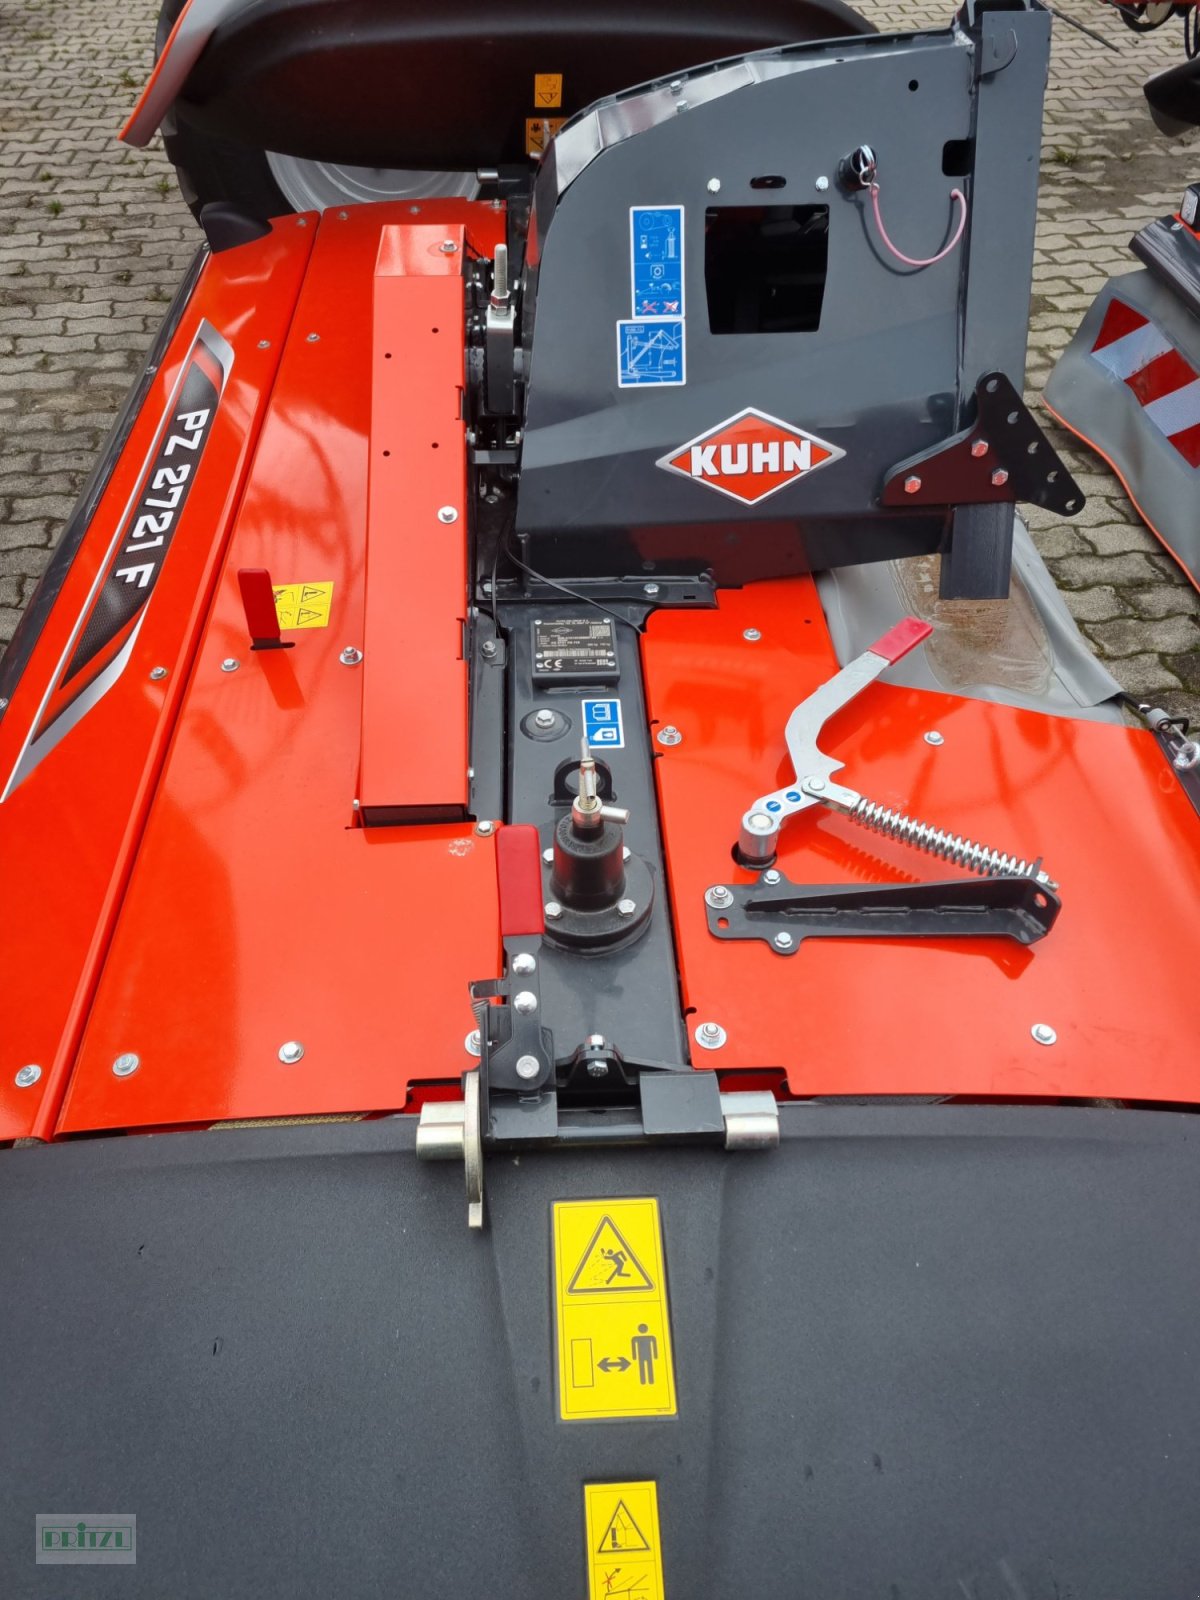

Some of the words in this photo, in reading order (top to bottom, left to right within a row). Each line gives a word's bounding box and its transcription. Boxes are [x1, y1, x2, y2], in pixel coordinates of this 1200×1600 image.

[165, 408, 210, 456] PZ
[690, 440, 811, 476] KUHN
[125, 464, 189, 553] 2721
[115, 562, 154, 588] F
